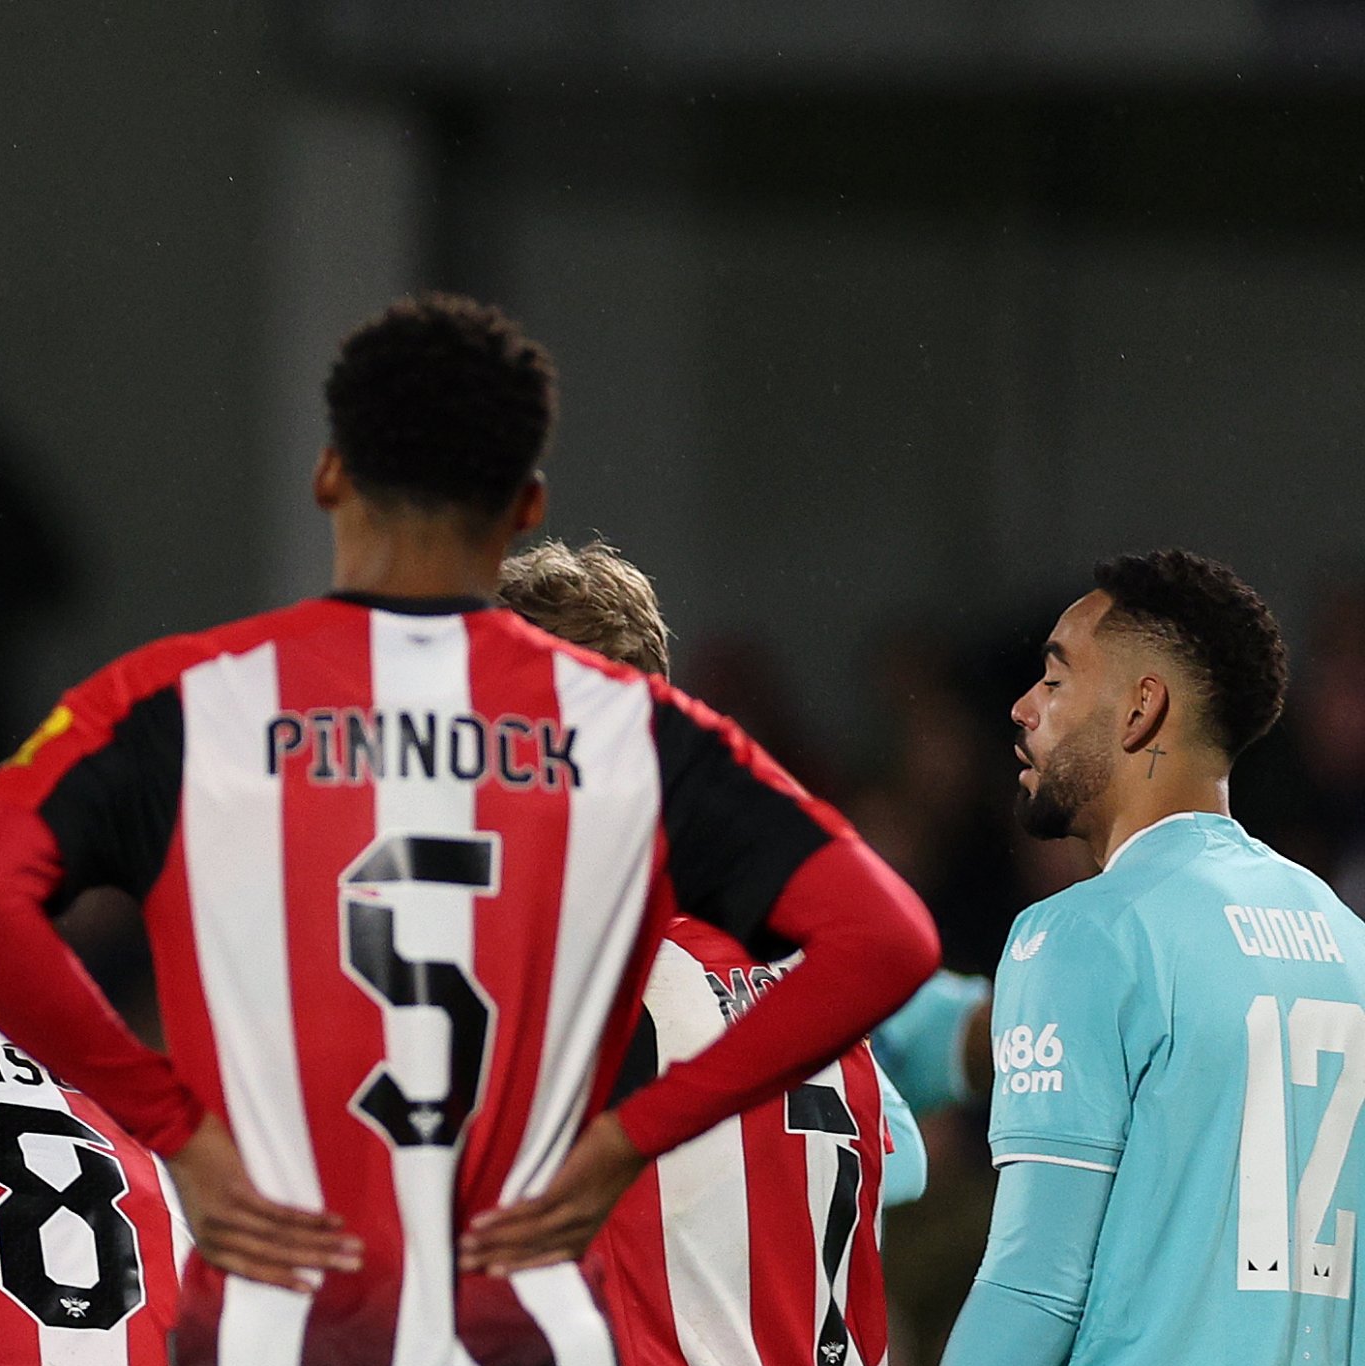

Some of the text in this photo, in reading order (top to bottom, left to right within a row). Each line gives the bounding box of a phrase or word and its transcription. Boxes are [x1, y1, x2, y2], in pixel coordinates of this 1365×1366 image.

[265, 707, 583, 789] PINNOCK
[339, 830, 501, 1148] 5
[1223, 904, 1345, 964] CUNHA
[1236, 995, 1365, 1300] 12
